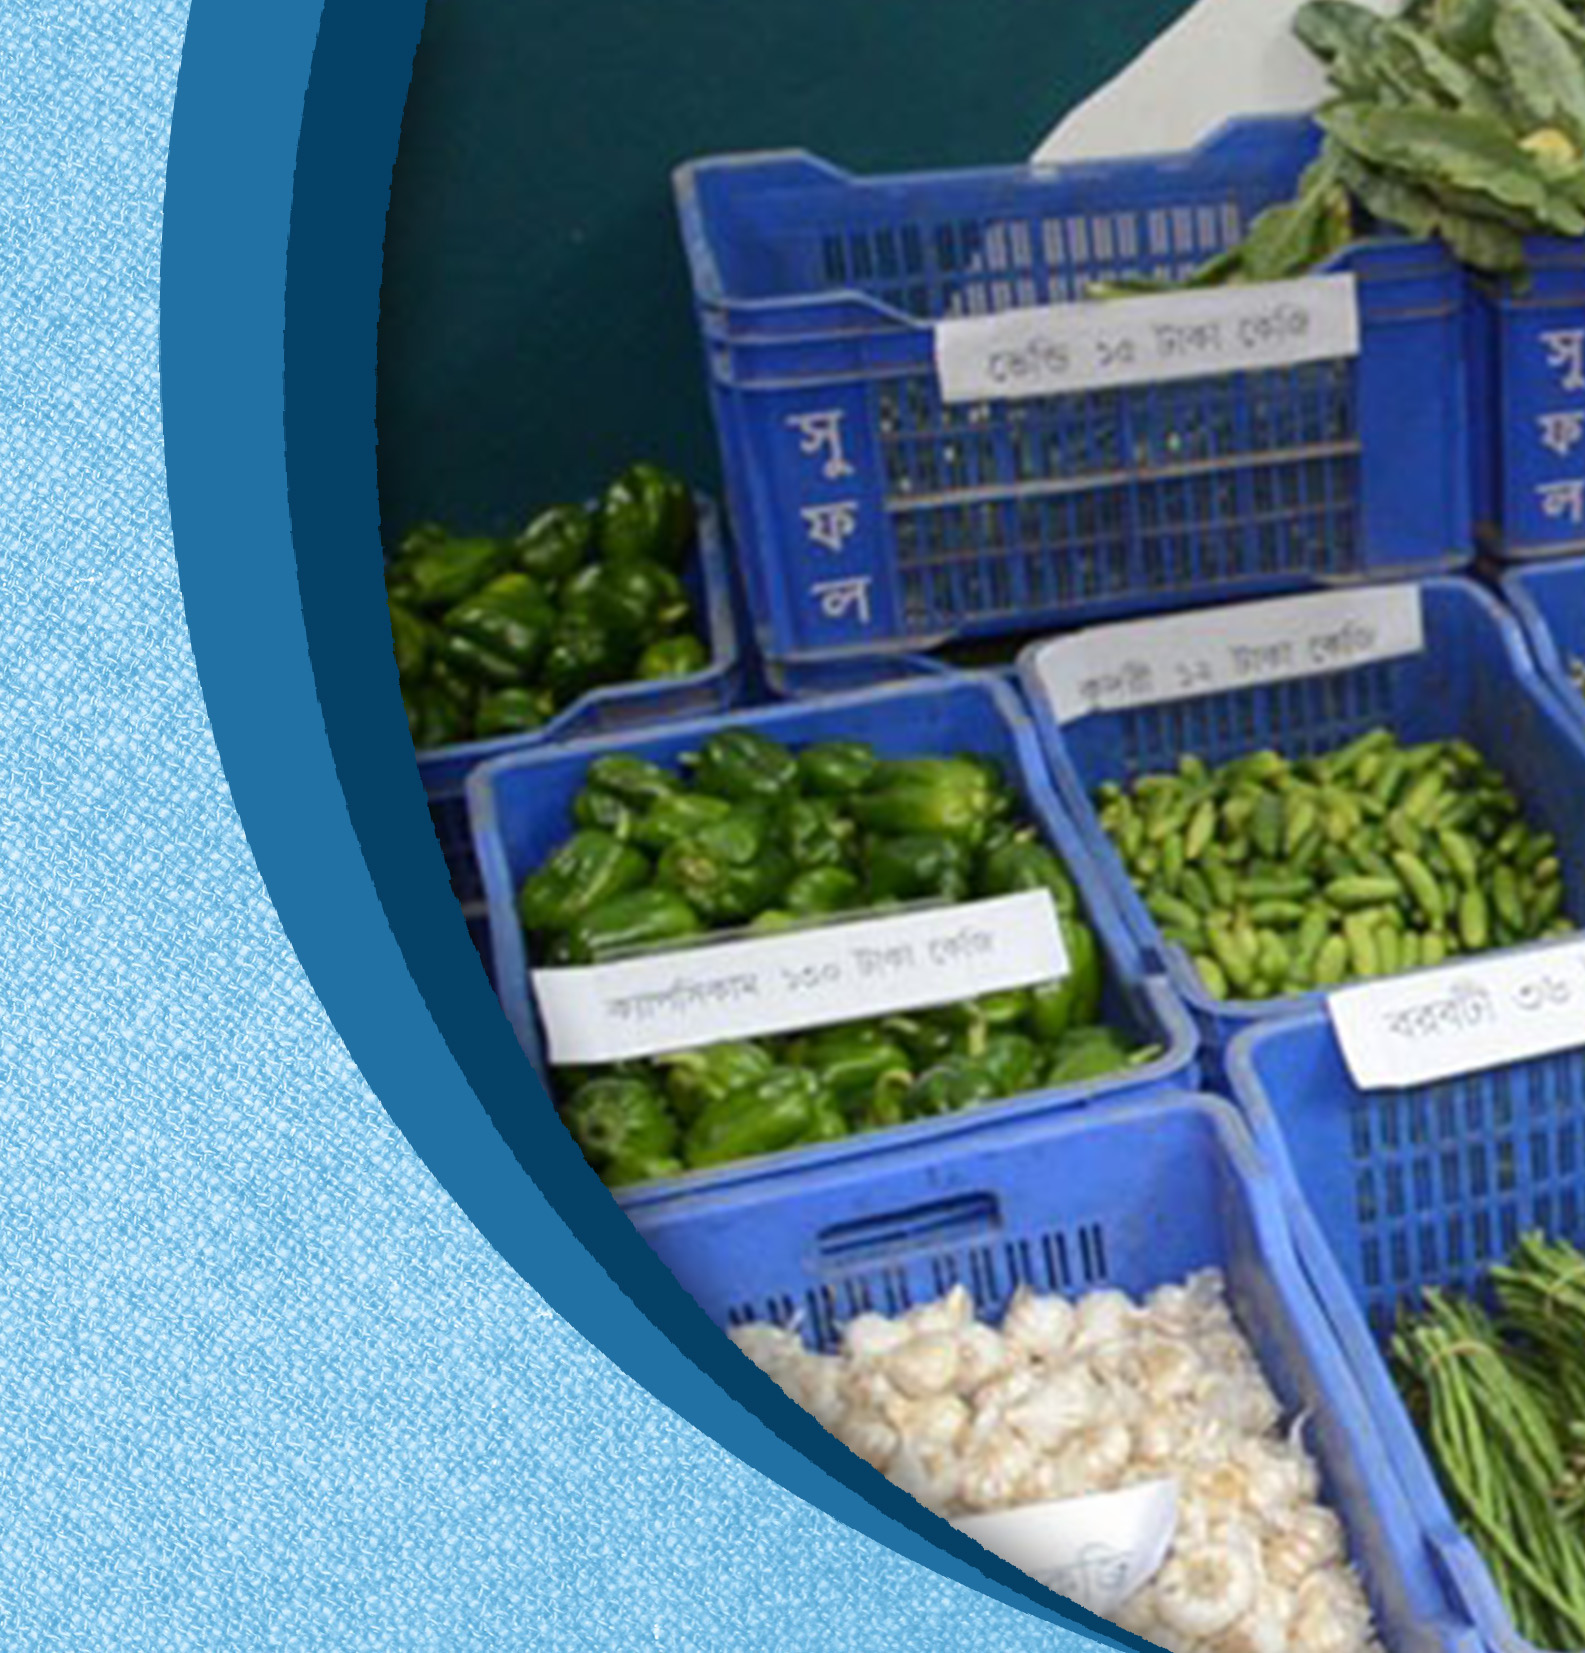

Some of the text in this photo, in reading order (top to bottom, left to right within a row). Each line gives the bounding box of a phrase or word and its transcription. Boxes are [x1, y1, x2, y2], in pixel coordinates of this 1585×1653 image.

[1153, 320, 1222, 358] টাকা
[1237, 303, 1310, 347] কেজি
[1227, 639, 1294, 675] টাকা
[1308, 619, 1378, 664] কেজি
[851, 944, 916, 978] টাকা
[928, 923, 995, 966] কেজি
